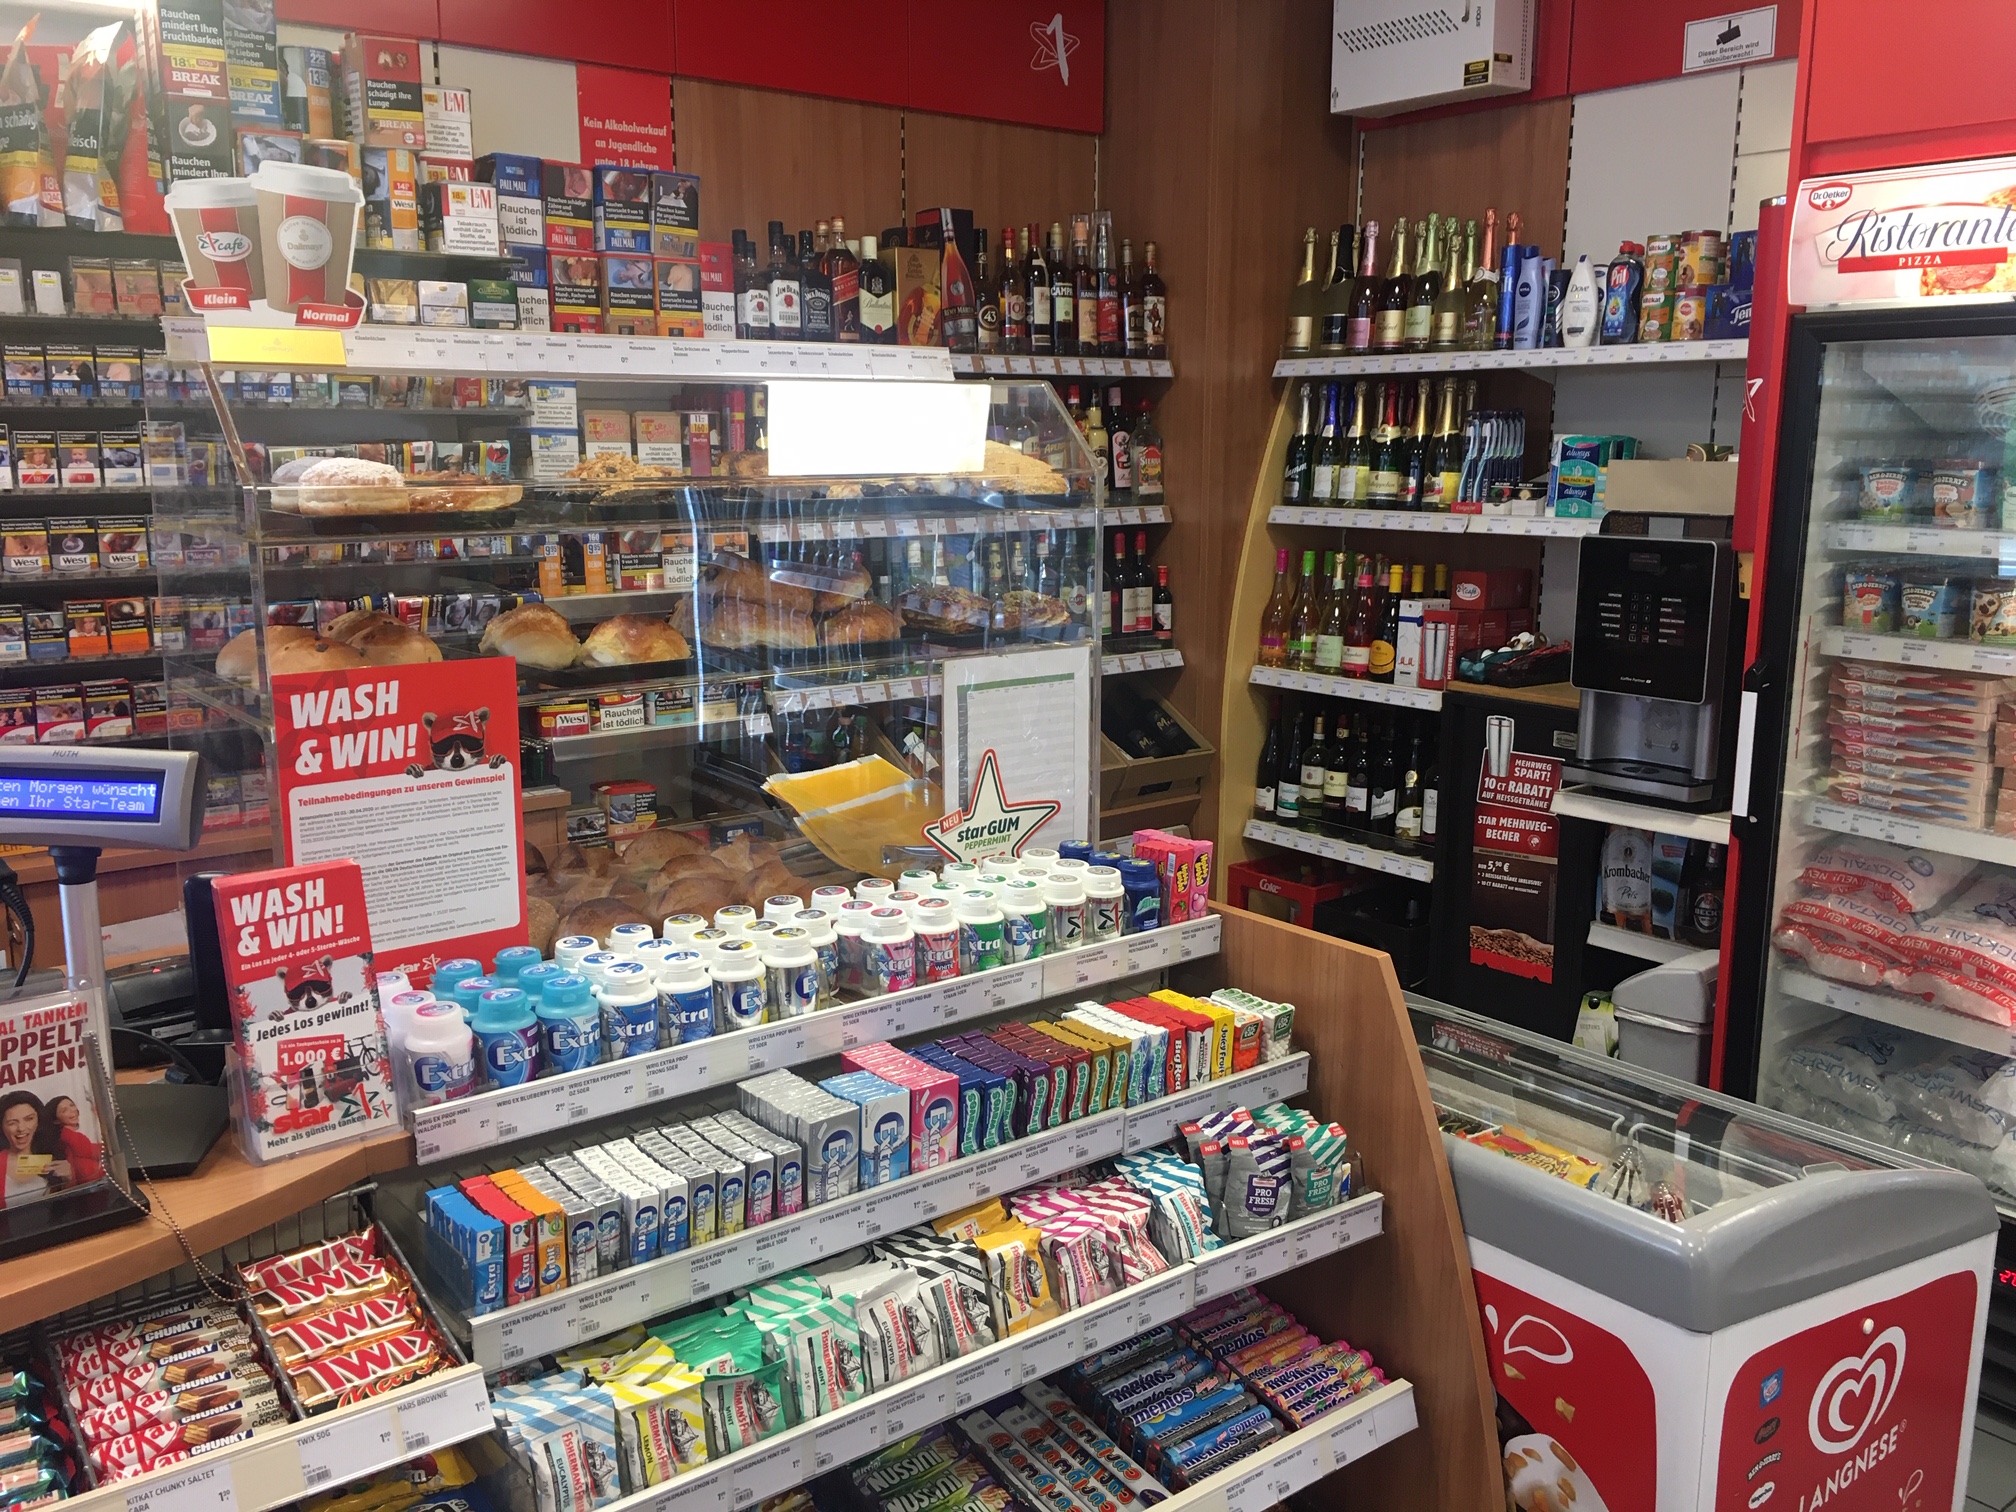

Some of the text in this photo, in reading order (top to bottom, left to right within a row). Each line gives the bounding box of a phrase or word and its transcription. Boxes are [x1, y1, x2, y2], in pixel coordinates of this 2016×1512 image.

[160, 9, 200, 21] Rauchen
[161, 21, 218, 35] mindert Ihre
[162, 31, 223, 46] Fruchtbarkeit
[1697, 40, 1760, 58] Dieser Bereich wird
[172, 70, 221, 86] BREAK
[367, 80, 396, 90] Rauchen
[368, 89, 412, 101] schädigt Ihre
[368, 98, 390, 109] Lunge
[379, 120, 413, 130] BREAK
[583, 116, 668, 137] Kein Alkoholverkauf
[595, 138, 658, 155] an Jugendliche
[619, 159, 630, 168] 18
[1822, 189, 1850, 200] Oetker
[394, 200, 414, 210] West
[500, 203, 541, 216] Rauchen
[515, 215, 528, 225] ist
[505, 226, 538, 237] tödlich
[217, 238, 244, 254] café
[287, 242, 323, 252] Dallmayr
[1899, 255, 1943, 267] PIZZA
[1610, 269, 1626, 284] Pril
[1570, 284, 1590, 293] Dove
[203, 293, 237, 306] Klein
[302, 309, 350, 323] Normal
[983, 310, 997, 323] 43
[62, 555, 88, 566] West
[289, 680, 399, 729] WASH
[604, 707, 643, 719] Rauchen
[559, 714, 587, 724] West
[602, 717, 645, 729] ist tödlich
[52, 750, 79, 758] HUTH
[295, 723, 418, 776] & WIN!
[1515, 758, 1552, 771] MEHRWEG
[1513, 767, 1551, 782] SPART!
[29, 780, 84, 796] Morgen
[92, 783, 157, 798] wünscht
[297, 773, 506, 808] Teilnahmebedingungen zu unserem Gewinnspiel
[1484, 777, 1553, 799] 10 CT RABATT
[28, 796, 53, 808] Ihr
[63, 796, 146, 812] Star-Team
[1481, 790, 1549, 809] AUF HEISSGETRÄNKE
[941, 812, 960, 832] NEU
[957, 815, 1021, 845] starGUM
[1477, 815, 1553, 833] STAR MEHRWEG-
[963, 833, 1012, 852] PEPPERMINT
[1485, 829, 1521, 843] BECHER
[1503, 862, 1510, 872] €
[1603, 864, 1651, 884] Krombacher
[1259, 878, 1282, 894] Coke
[1617, 886, 1639, 900] Pils
[229, 878, 325, 927] WASH
[237, 926, 261, 957] &
[266, 904, 344, 949] WIN!
[240, 962, 252, 972] Ein
[252, 960, 263, 970] Los
[263, 958, 271, 967] zu
[271, 954, 288, 966] jeder
[296, 948, 310, 958] oder
[310, 935, 361, 955] 5-Sterne-Wäsche
[23, 1001, 88, 1031] TANKEN
[256, 999, 370, 1042] Jedes Los gewinnt!
[552, 1026, 599, 1050] Extra
[1221, 1026, 1229, 1050] Juicy
[280, 1046, 342, 1067] 1.000 €
[423, 1058, 475, 1085] Extra
[569, 1069, 632, 1090] WRIG EXTRA PEPPERMINT
[497, 1099, 511, 1108] WRIG
[520, 1089, 551, 1103] BLUEBERRY
[272, 1102, 335, 1135] star
[266, 1134, 290, 1149] Mehr
[290, 1130, 304, 1142] als
[304, 1122, 337, 1140] günstig
[1232, 1138, 1245, 1146] NEU
[828, 1137, 846, 1199] Extra
[1248, 1195, 1276, 1206] FRESH
[1254, 1188, 1272, 1197] PRO
[484, 1263, 498, 1300] Extra
[267, 1291, 410, 1360] TWIX
[501, 1303, 567, 1330] EXTRA TROPICAL FRUIT
[145, 1319, 199, 1343] CHUNKY
[287, 1328, 442, 1396] TWIX
[817, 1365, 826, 1386] MINT
[71, 1360, 157, 1412] KitKat
[397, 1390, 449, 1413] MARS BROWNIE
[1130, 1387, 1195, 1428] mentos
[296, 1429, 331, 1448] TWIX 50G
[643, 1434, 653, 1465] LEMON
[1798, 1423, 1900, 1512] LANGNESE
[126, 1468, 216, 1507] KITKAT CHUNKY SALTET
[556, 1457, 570, 1509] EUCALYPTUS
